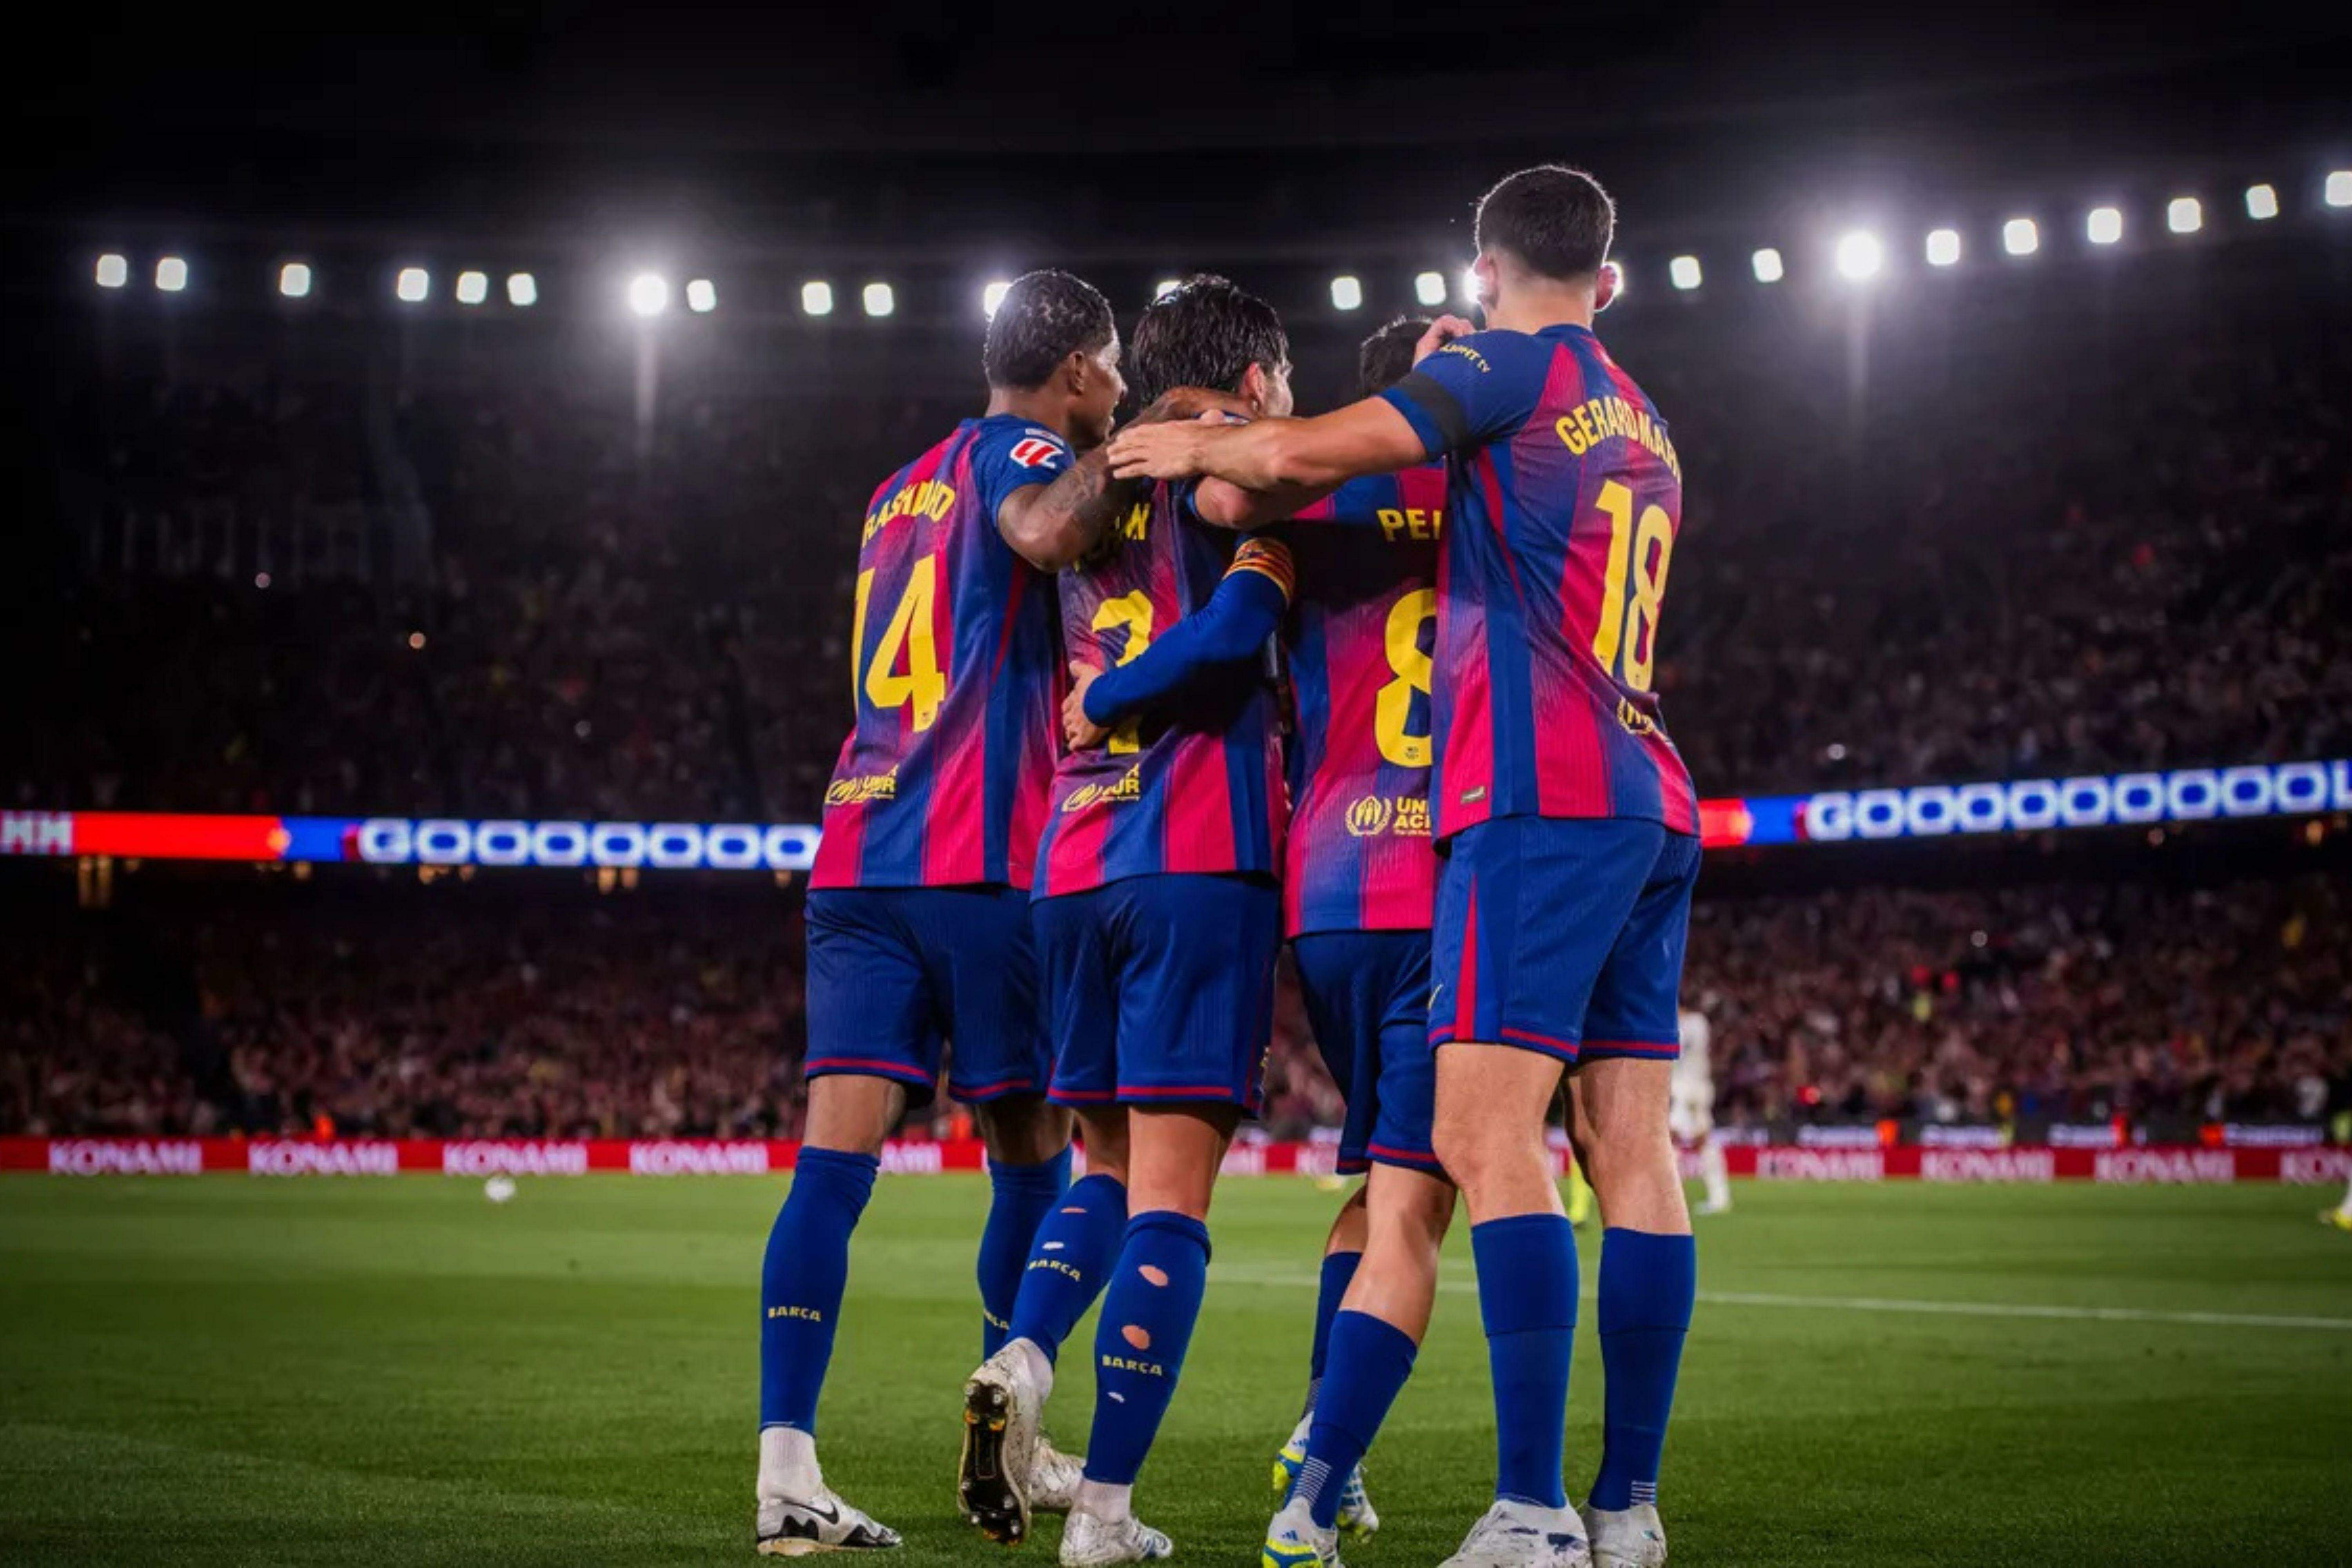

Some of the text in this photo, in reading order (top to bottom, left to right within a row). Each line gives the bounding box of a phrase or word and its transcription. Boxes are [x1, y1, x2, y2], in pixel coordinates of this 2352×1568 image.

[851, 554, 945, 732] 14
[1592, 477, 1673, 692] 18
[1375, 588, 1437, 768] 8
